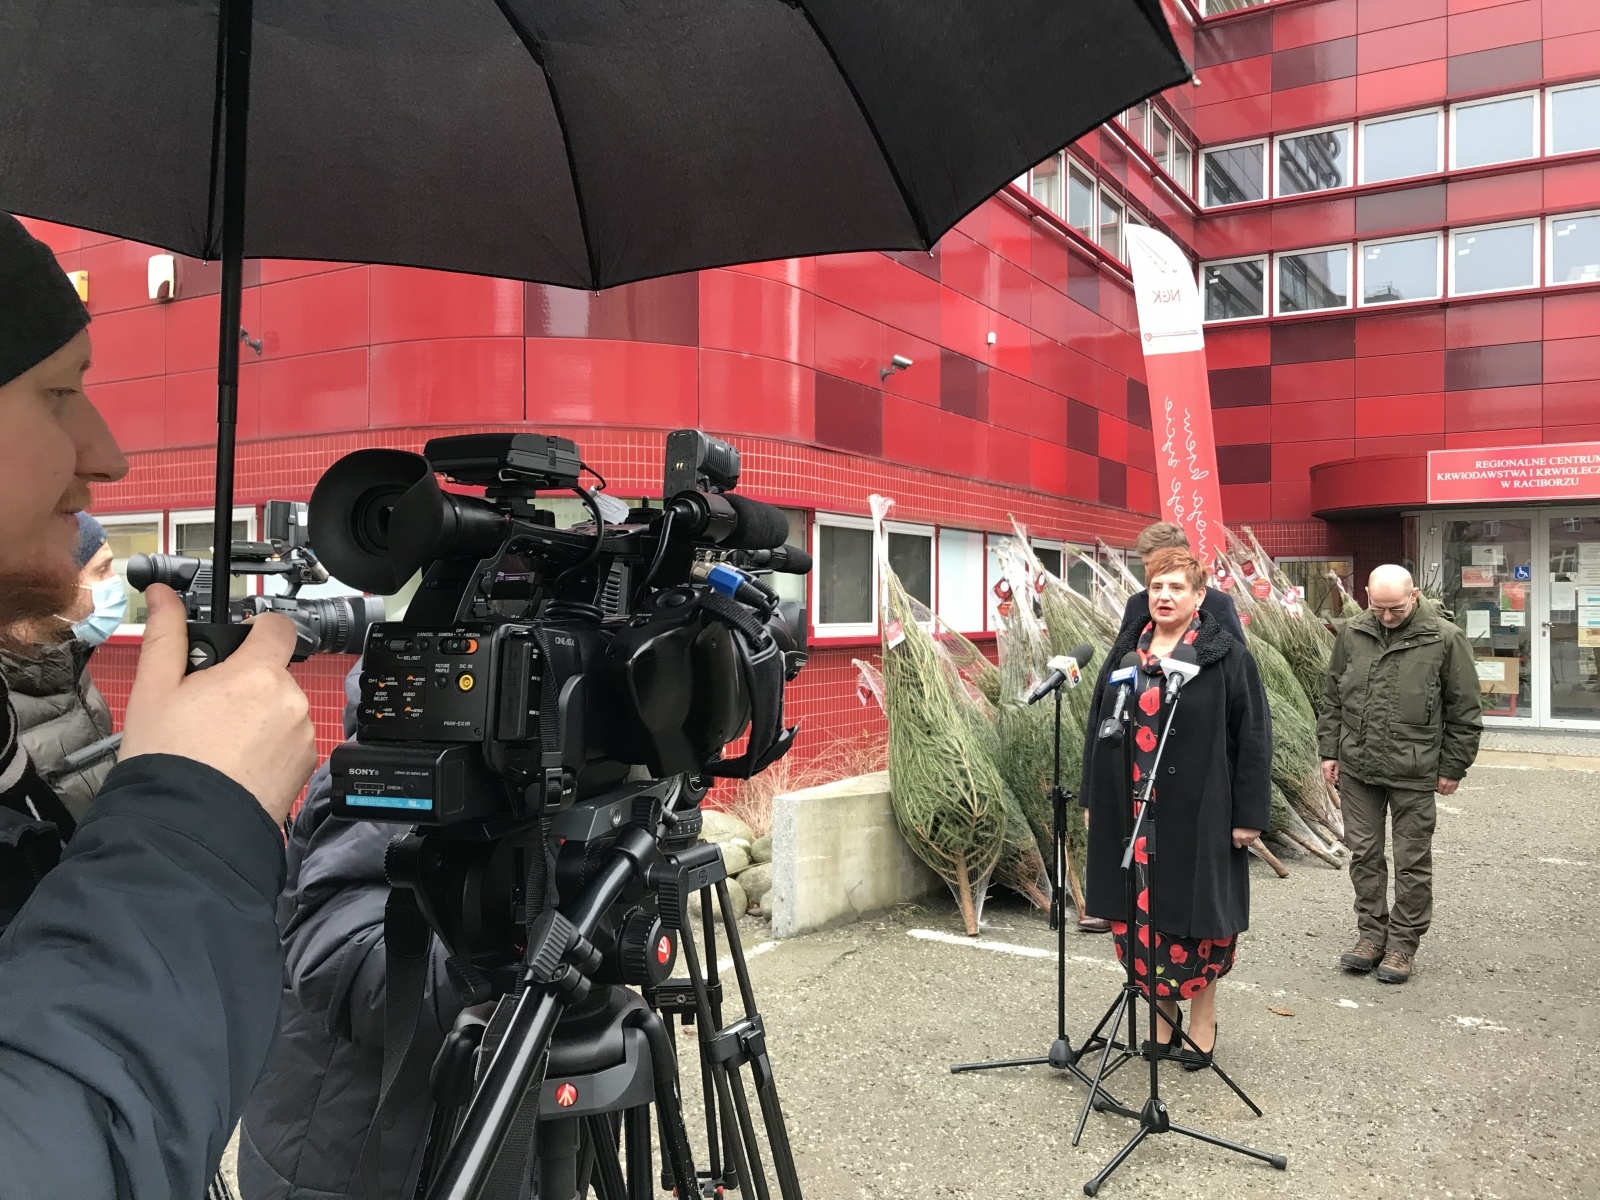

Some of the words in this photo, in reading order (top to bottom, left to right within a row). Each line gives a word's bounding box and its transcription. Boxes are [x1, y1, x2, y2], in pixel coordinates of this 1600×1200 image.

[1475, 458, 1547, 468] REGIONALNE
[1437, 470, 1527, 481] KRWIODAWSTWA
[1501, 480, 1511, 489] W
[1513, 477, 1579, 488] RACIBORZU
